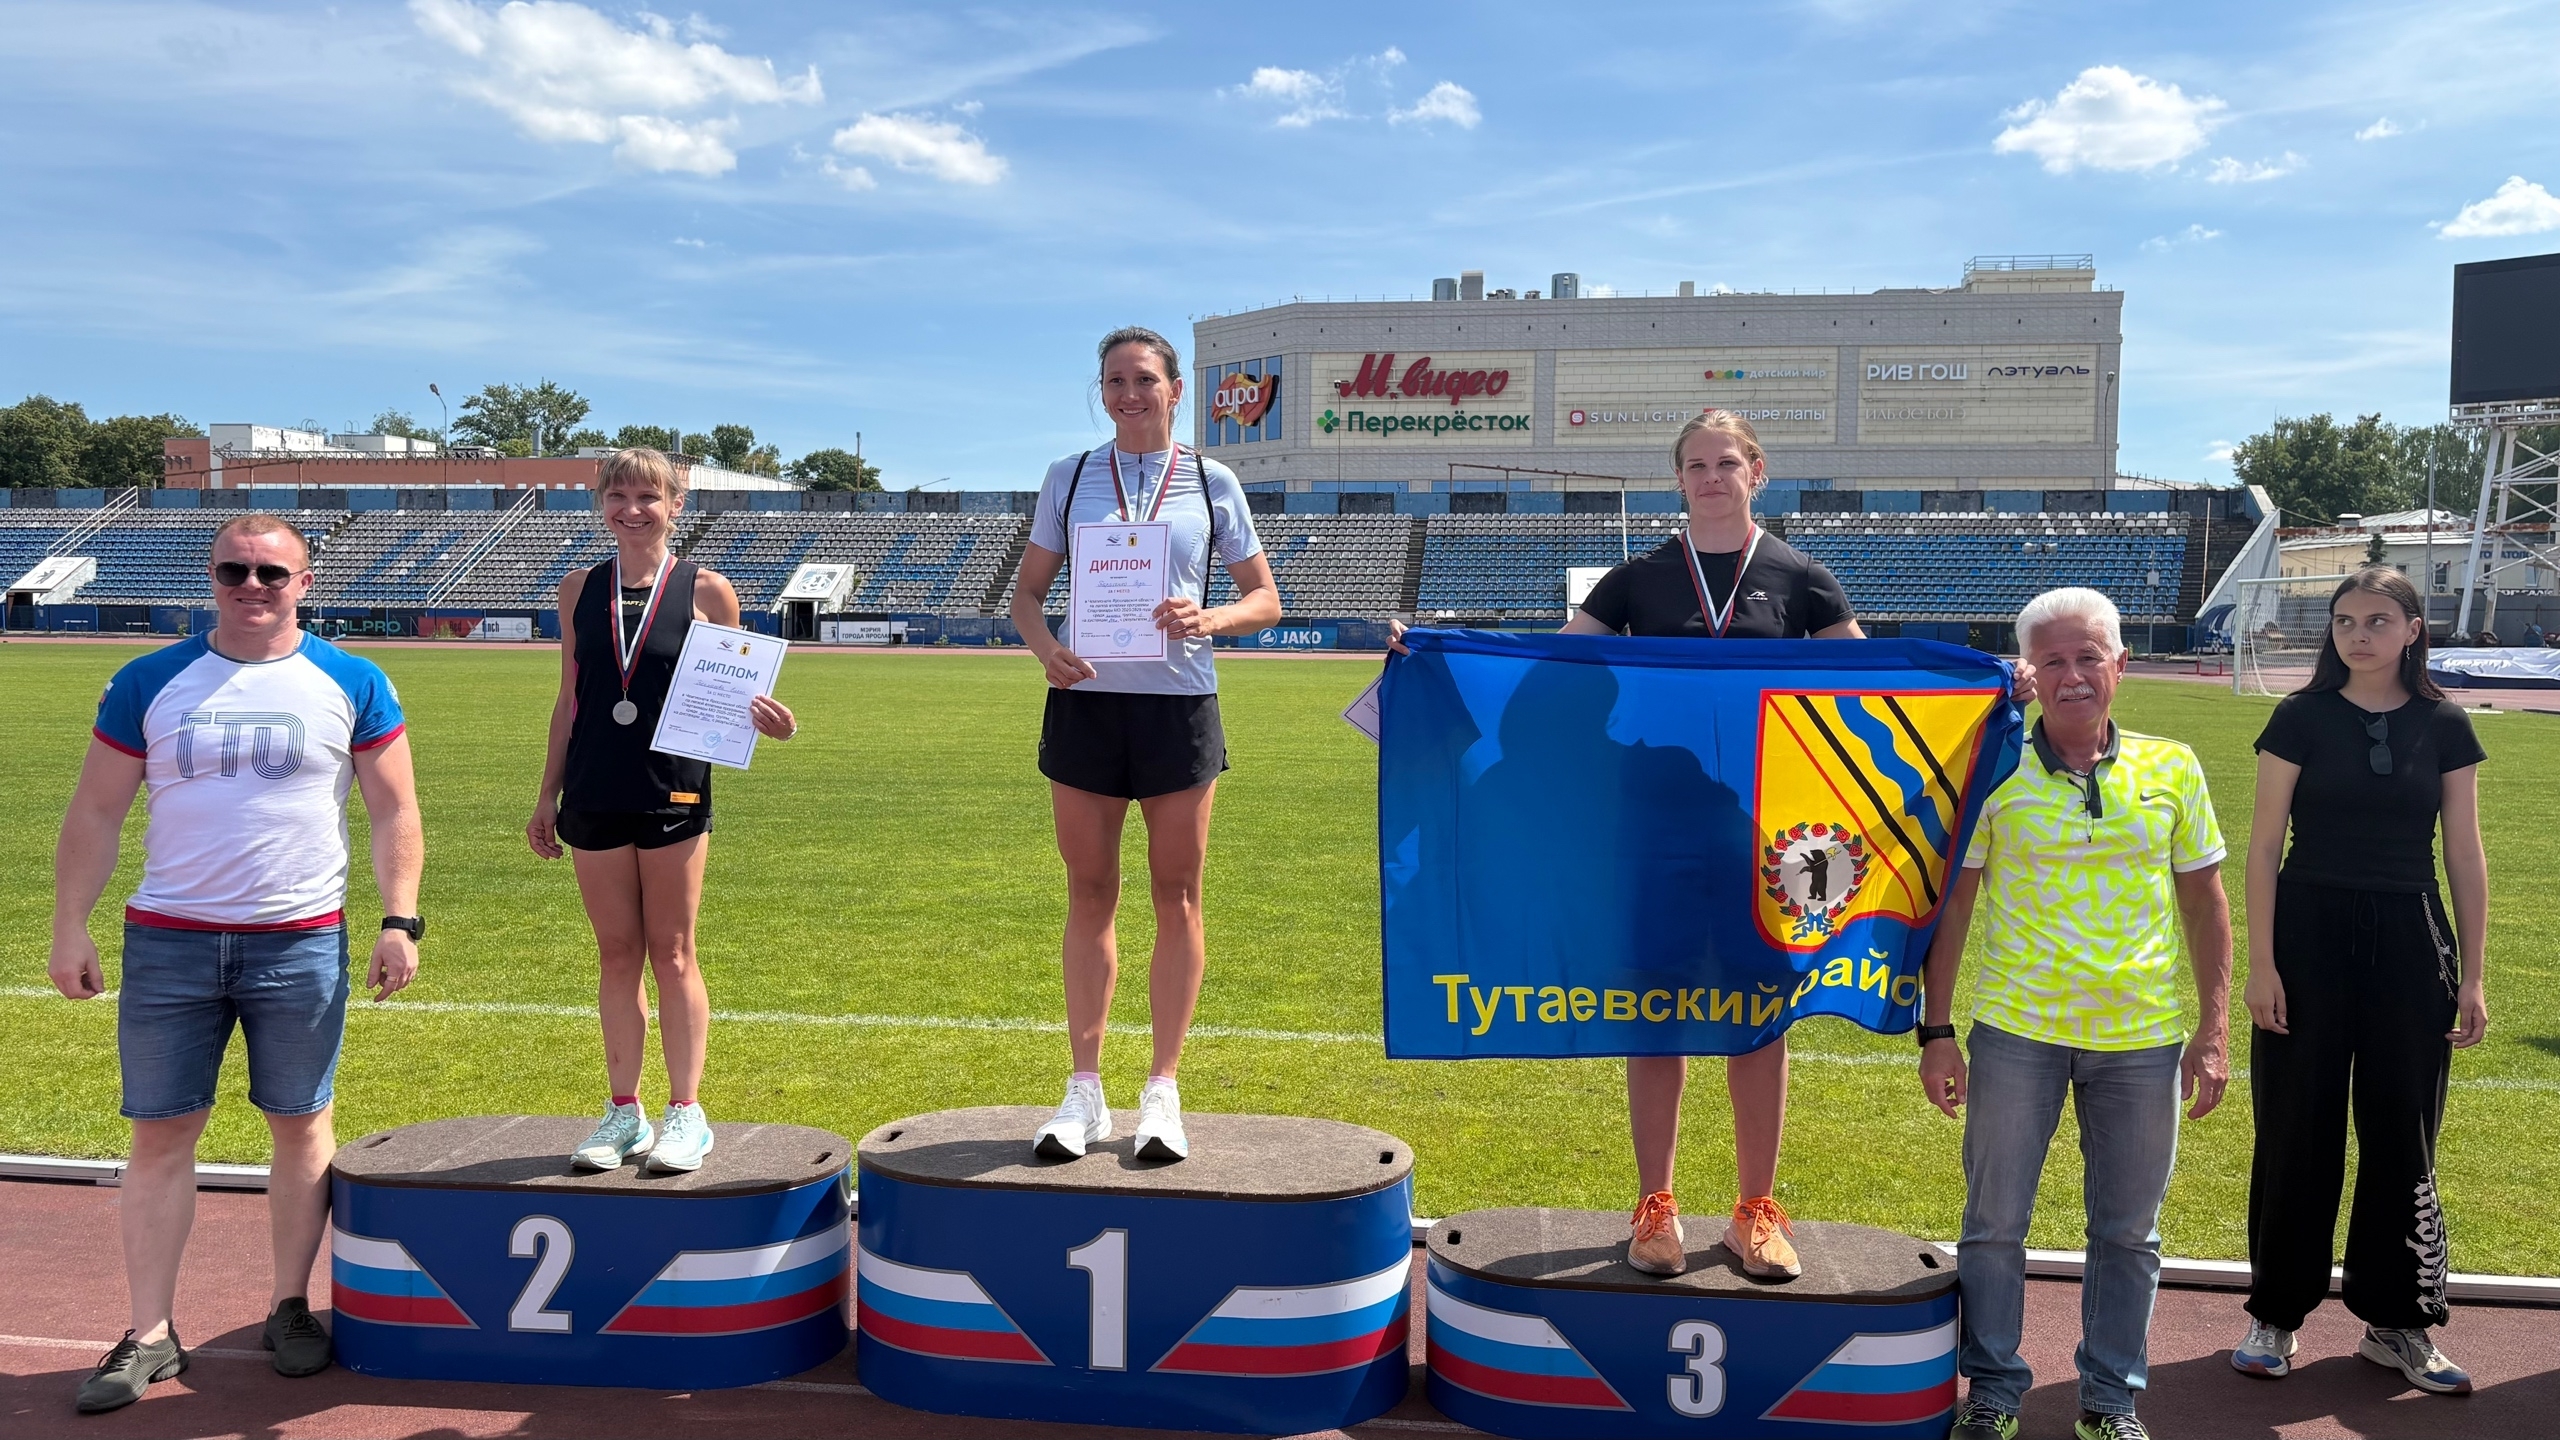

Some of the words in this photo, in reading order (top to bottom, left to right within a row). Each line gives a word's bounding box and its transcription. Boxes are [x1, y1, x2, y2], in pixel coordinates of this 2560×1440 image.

[1339, 353, 1510, 405] М.видео
[1866, 364, 1913, 381] РИВ
[1918, 363, 1968, 381] ГОШ
[1215, 384, 1260, 414] аура
[1348, 410, 1531, 437] Перекрёсток
[1590, 410, 1690, 423] SUNLIGHT
[1784, 409, 1826, 421] лапы
[1088, 559, 1151, 574] ДИПЛОМ
[1281, 630, 1322, 645] JAKO
[694, 659, 758, 682] ДИПЛОМ
[176, 711, 305, 780] ГТО
[1432, 973, 1783, 1035] Тутаевский
[1790, 947, 1924, 1009] райо
[508, 1214, 575, 1334] 2
[1067, 1228, 1128, 1371] 1
[1666, 1319, 1727, 1418] 3
